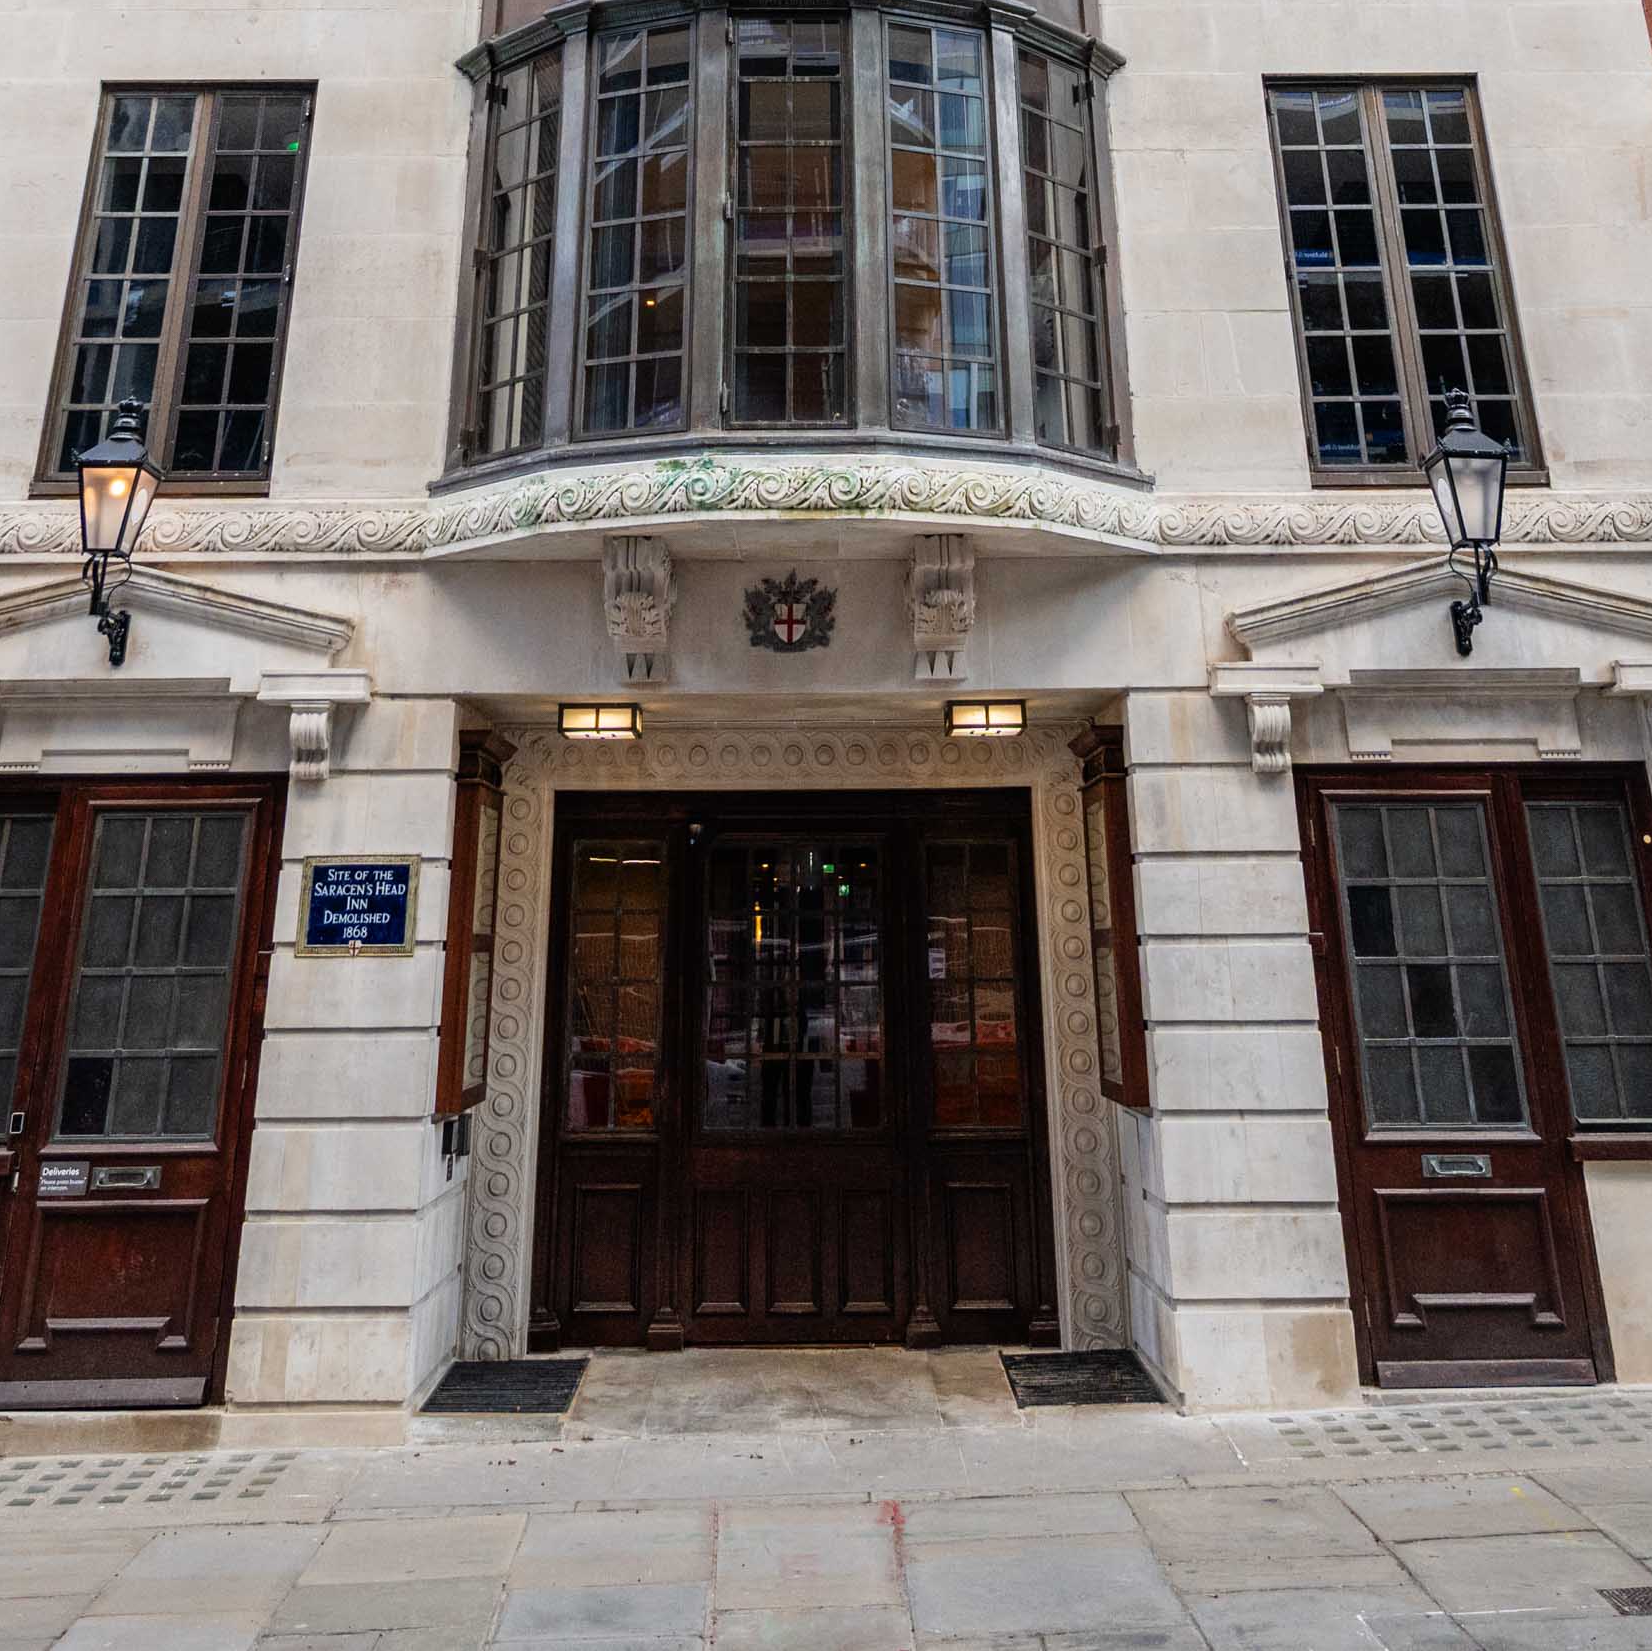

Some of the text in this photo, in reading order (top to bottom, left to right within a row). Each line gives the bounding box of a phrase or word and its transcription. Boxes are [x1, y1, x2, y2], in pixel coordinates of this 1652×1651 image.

[328, 868, 394, 881] SITE OF THE
[314, 881, 406, 896] SARACEN'S HEAD
[346, 896, 368, 910] INN
[324, 910, 390, 924] DEMOLISHED
[343, 926, 368, 938] 1868
[42, 1167, 80, 1176] Deliveries
